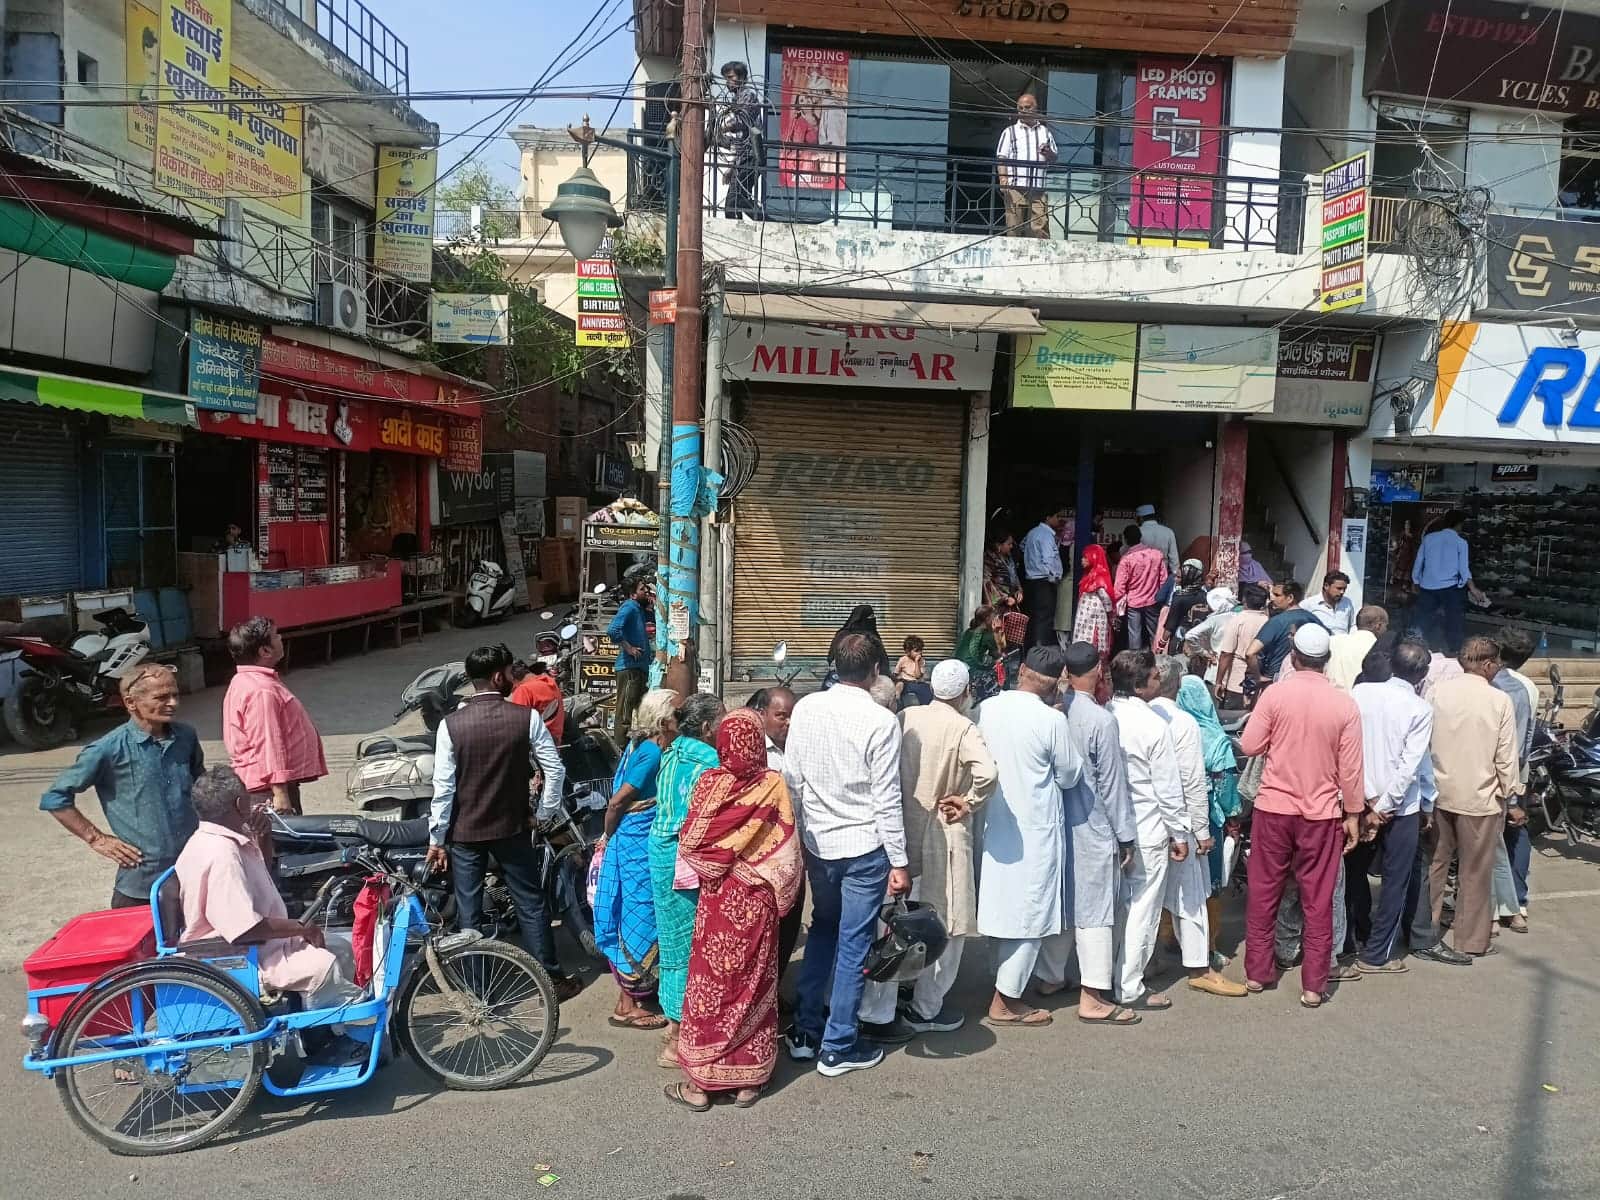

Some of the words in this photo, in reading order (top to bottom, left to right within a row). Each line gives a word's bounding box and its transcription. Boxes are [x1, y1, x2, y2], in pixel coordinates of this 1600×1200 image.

[170, 4, 223, 62] सच्चाई
[185, 46, 208, 78] का
[787, 47, 845, 61] WEDDING
[1560, 45, 1600, 84] B
[1141, 67, 1165, 82] LED
[1170, 68, 1216, 86] PHOTO
[1149, 85, 1207, 101] FRAMES
[1325, 165, 1347, 191] PRINT
[1348, 158, 1364, 180] OUT
[1324, 200, 1344, 221] PHOTO
[1346, 192, 1364, 213] COPY
[1324, 224, 1347, 244] PASSPORT
[1347, 217, 1364, 236] PHOTO
[1323, 247, 1341, 268] PHOTO
[1342, 240, 1364, 262] FRAME
[1325, 265, 1361, 289] LAMINATION
[583, 300, 625, 311] BIRTHDA
[752, 344, 856, 377] MILK
[1497, 464, 1528, 475] sparx
